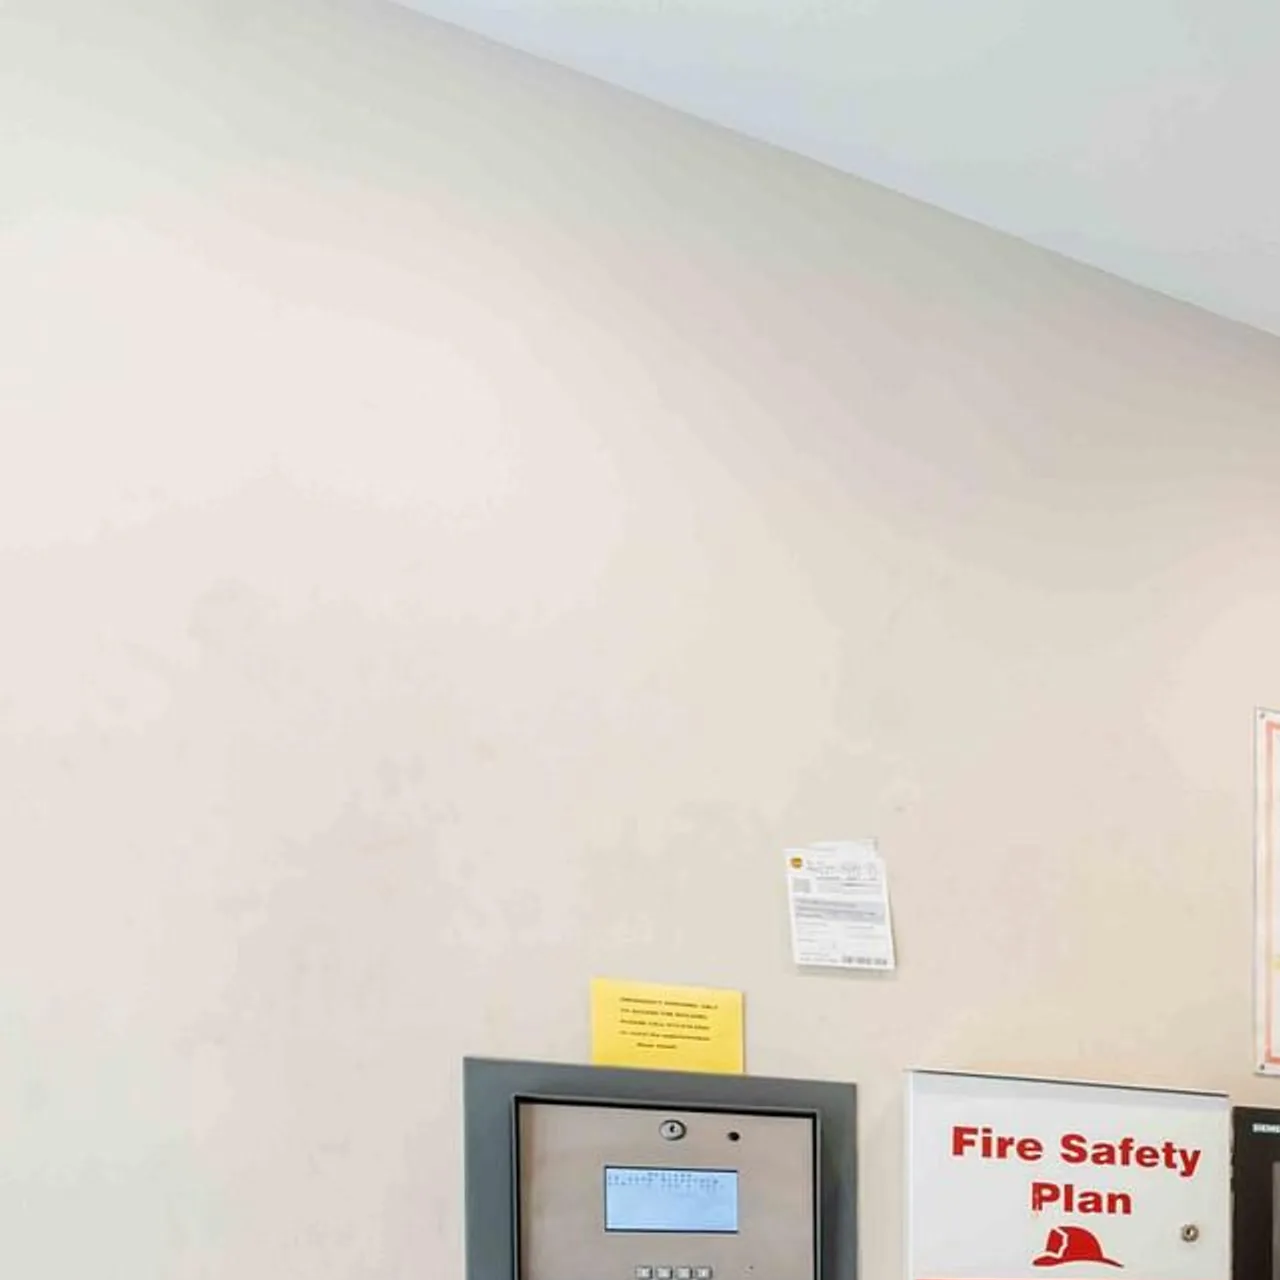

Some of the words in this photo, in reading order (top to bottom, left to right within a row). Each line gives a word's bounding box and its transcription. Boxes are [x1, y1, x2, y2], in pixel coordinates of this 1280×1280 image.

[952, 1126, 1044, 1162] Fire
[1060, 1133, 1202, 1178] Safety
[1031, 1182, 1133, 1215] Plan
